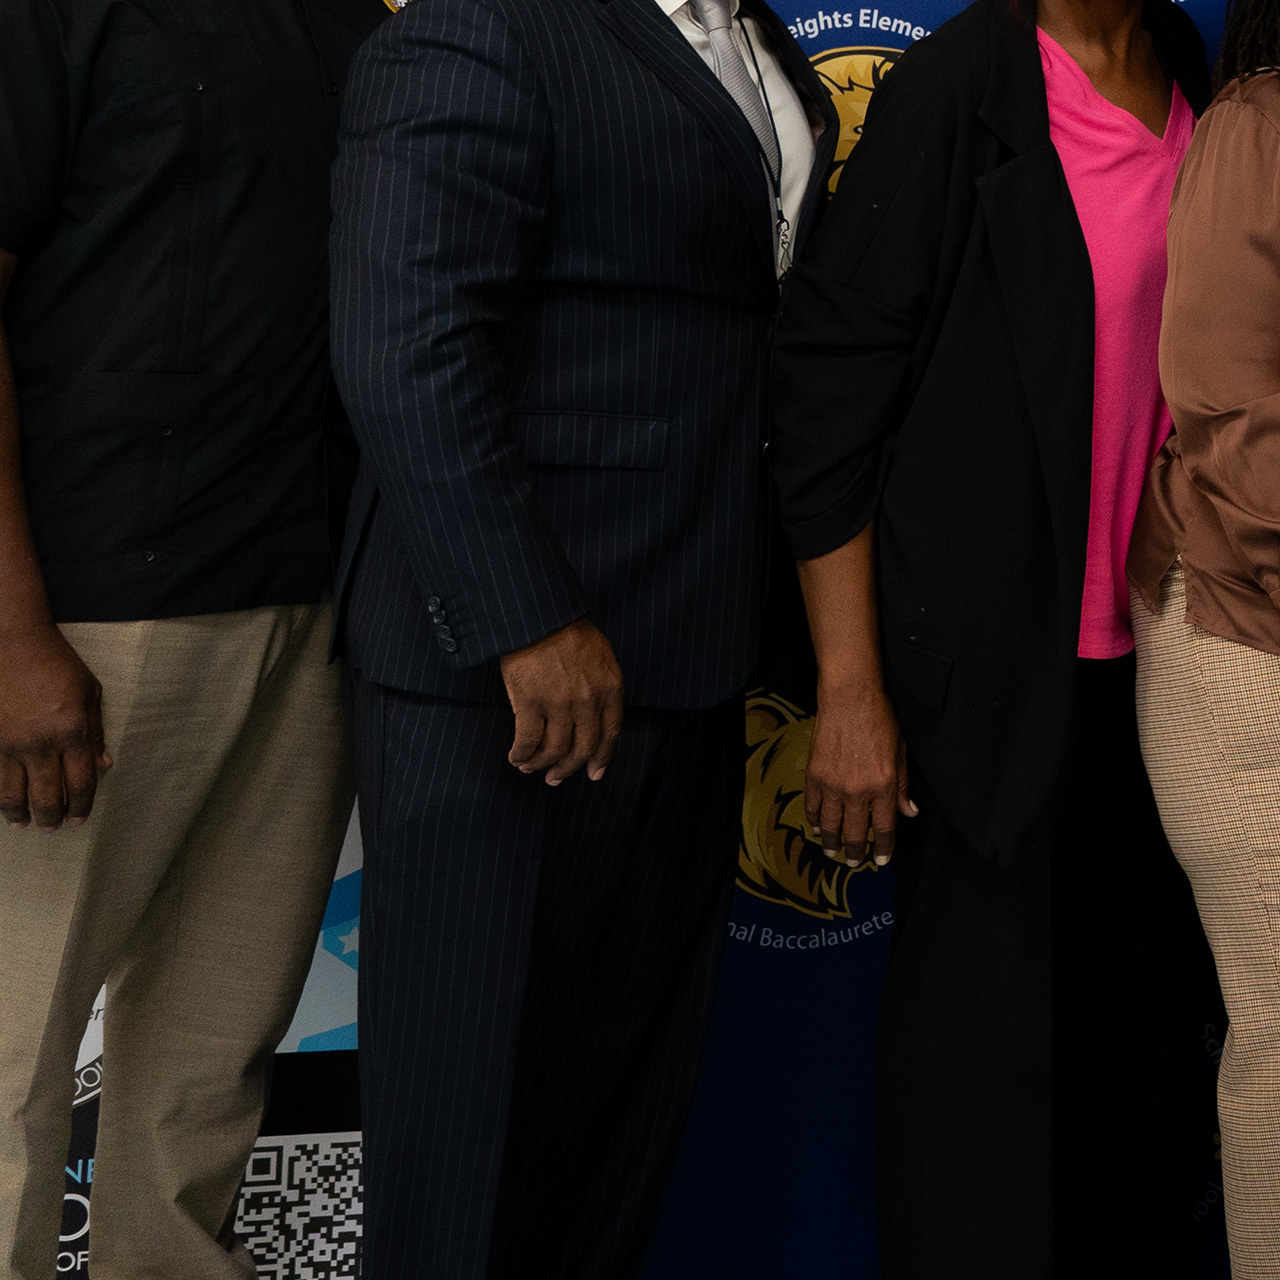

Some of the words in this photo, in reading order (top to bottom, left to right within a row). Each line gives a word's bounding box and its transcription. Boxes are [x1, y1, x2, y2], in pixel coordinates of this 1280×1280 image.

[787, 10, 854, 40] eights
[858, 8, 932, 41] Eleme
[759, 910, 895, 950] Baccalaurete
